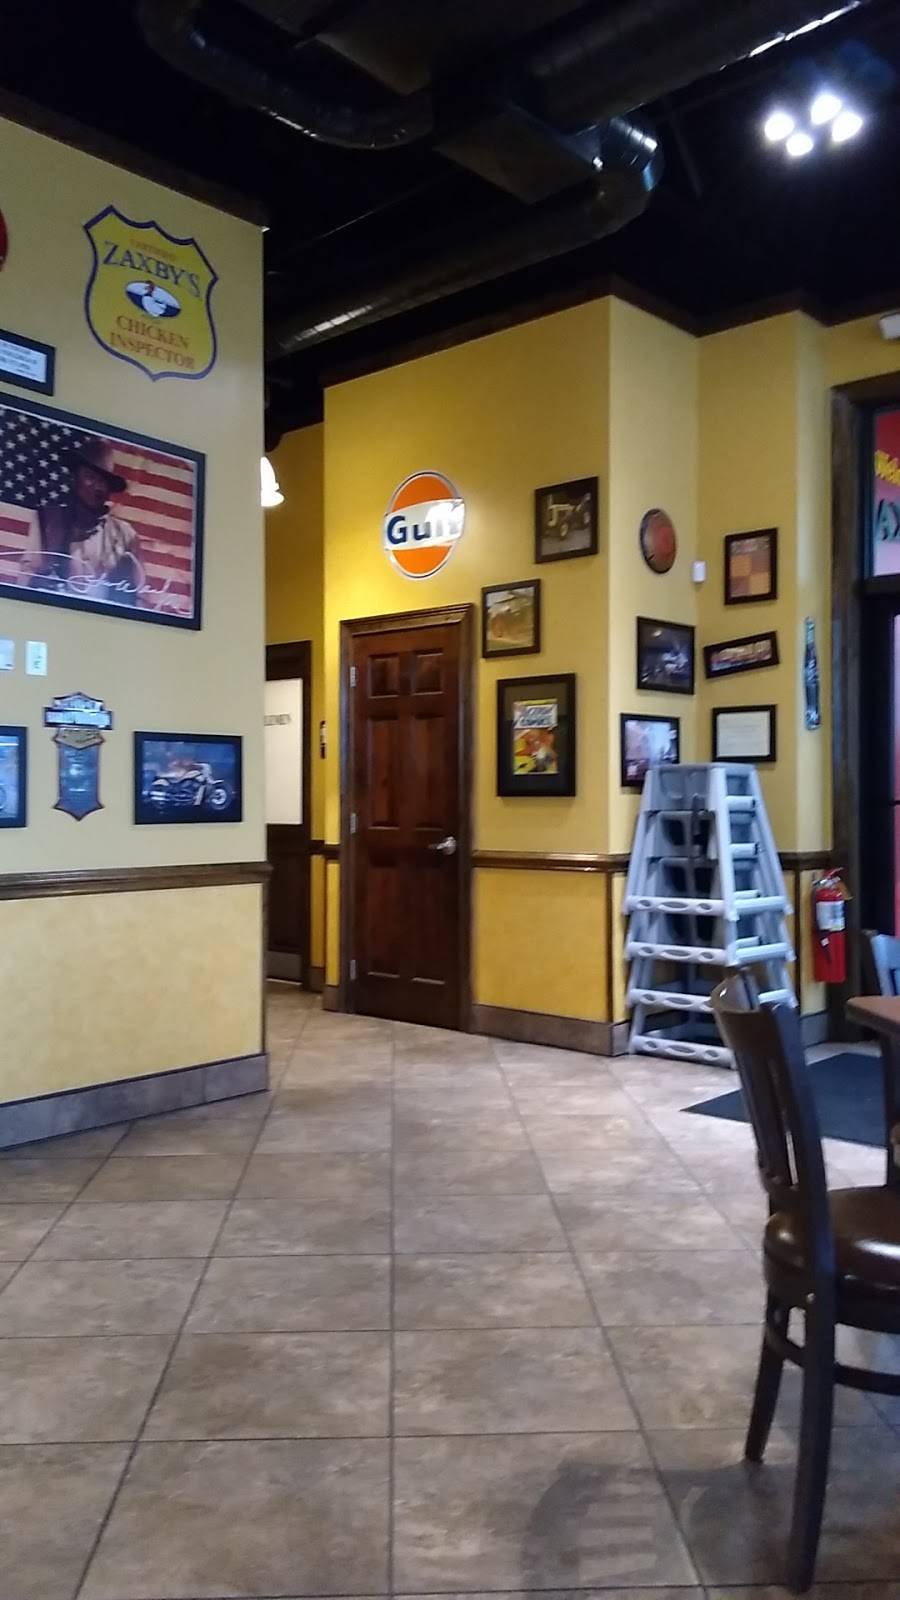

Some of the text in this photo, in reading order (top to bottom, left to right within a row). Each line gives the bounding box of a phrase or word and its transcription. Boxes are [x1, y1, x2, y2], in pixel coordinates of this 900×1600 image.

[102, 240, 202, 299] ZAXBY'S
[110, 332, 195, 369] INSPECTOR
[116, 315, 189, 349] CHICKEN
